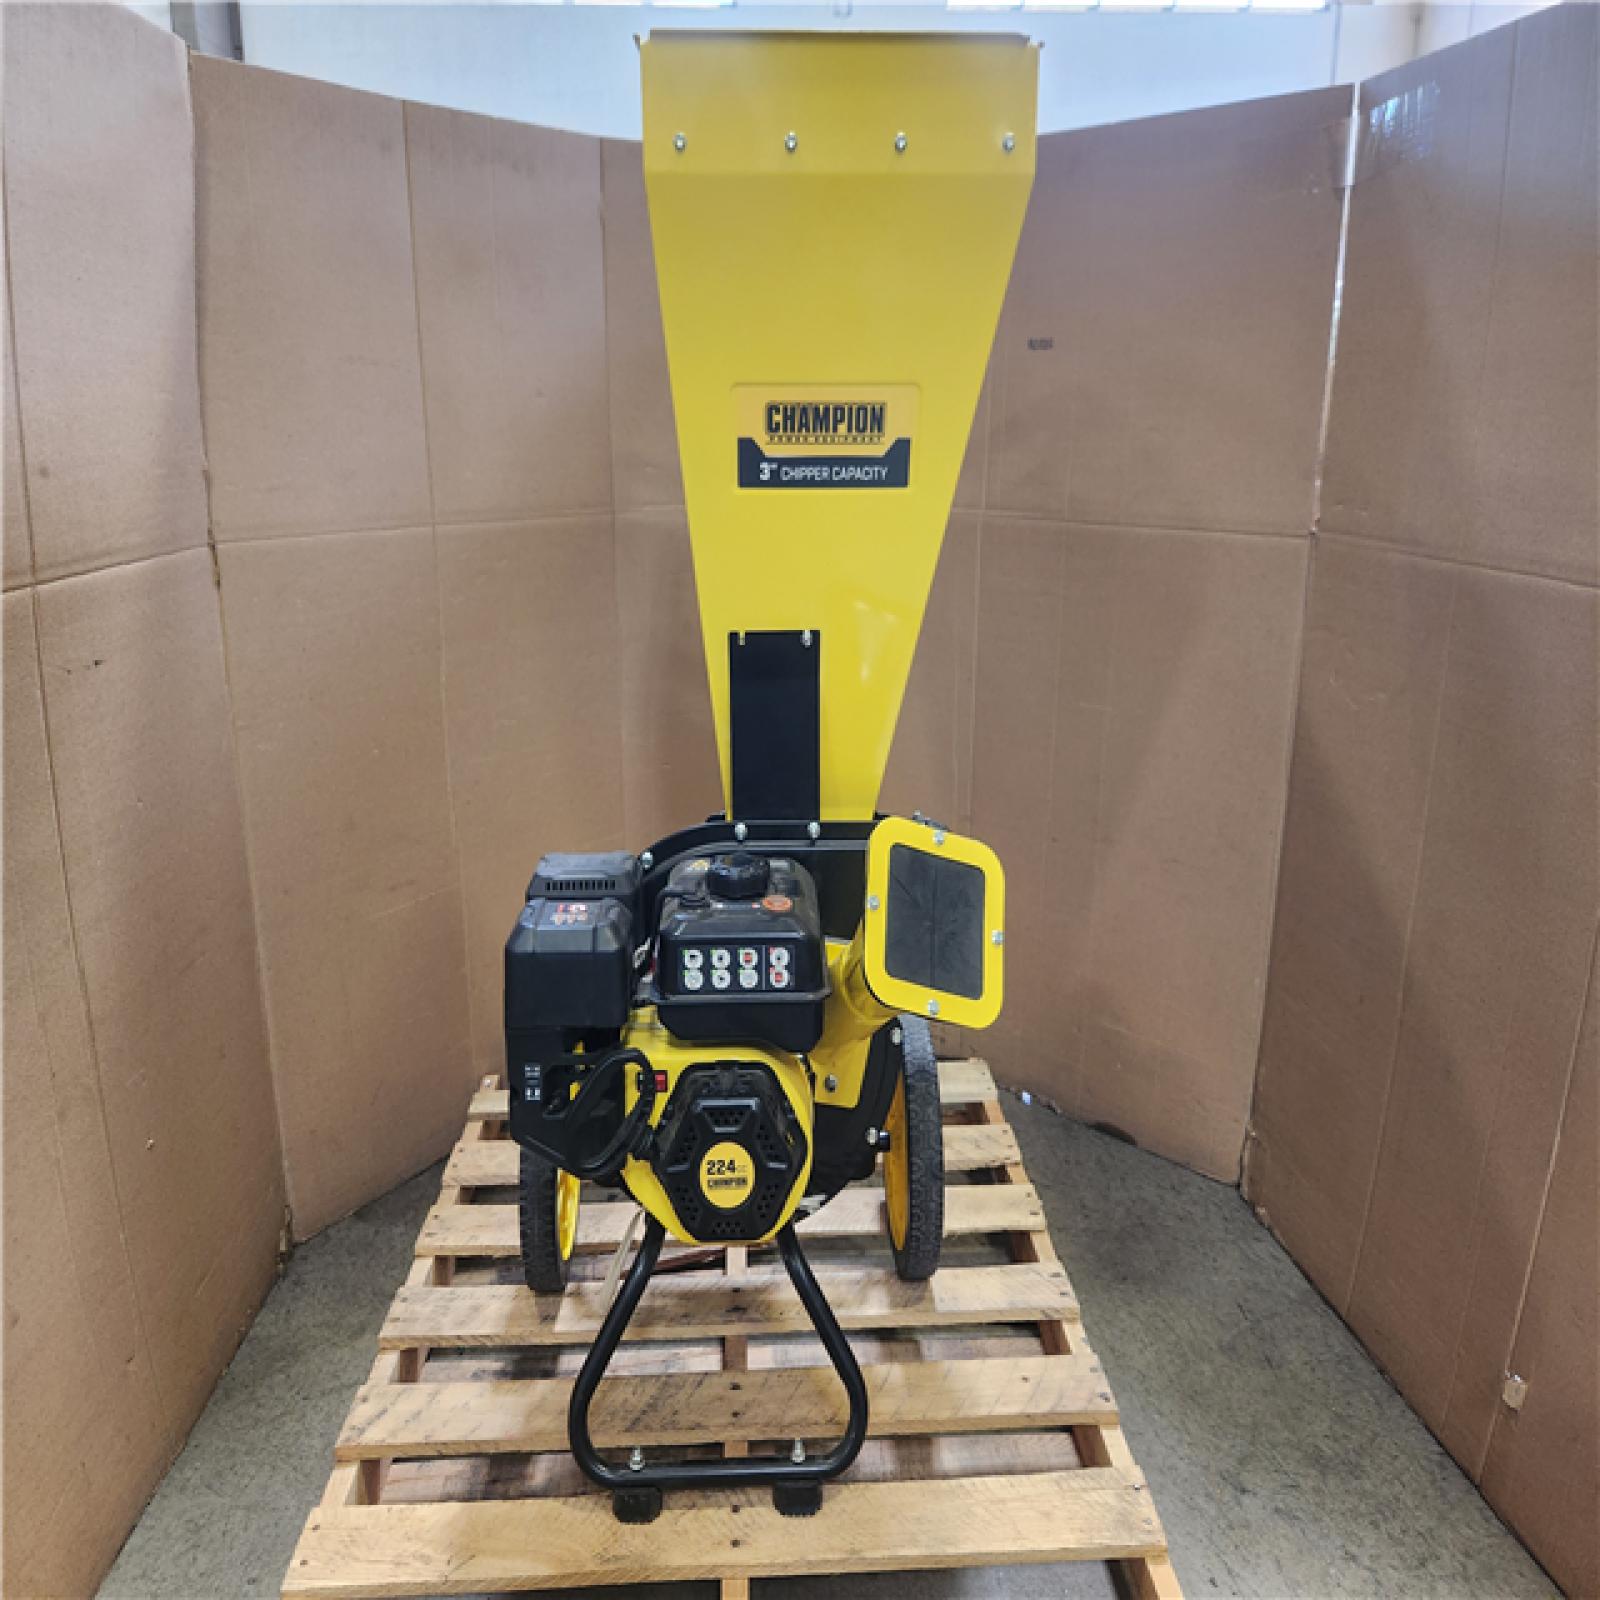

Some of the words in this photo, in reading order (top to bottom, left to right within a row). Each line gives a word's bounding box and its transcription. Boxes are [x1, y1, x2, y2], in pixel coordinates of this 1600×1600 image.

[765, 403, 885, 434] CHAMPION
[780, 465, 830, 481] CHIPPER
[832, 465, 888, 481] CAPACITY
